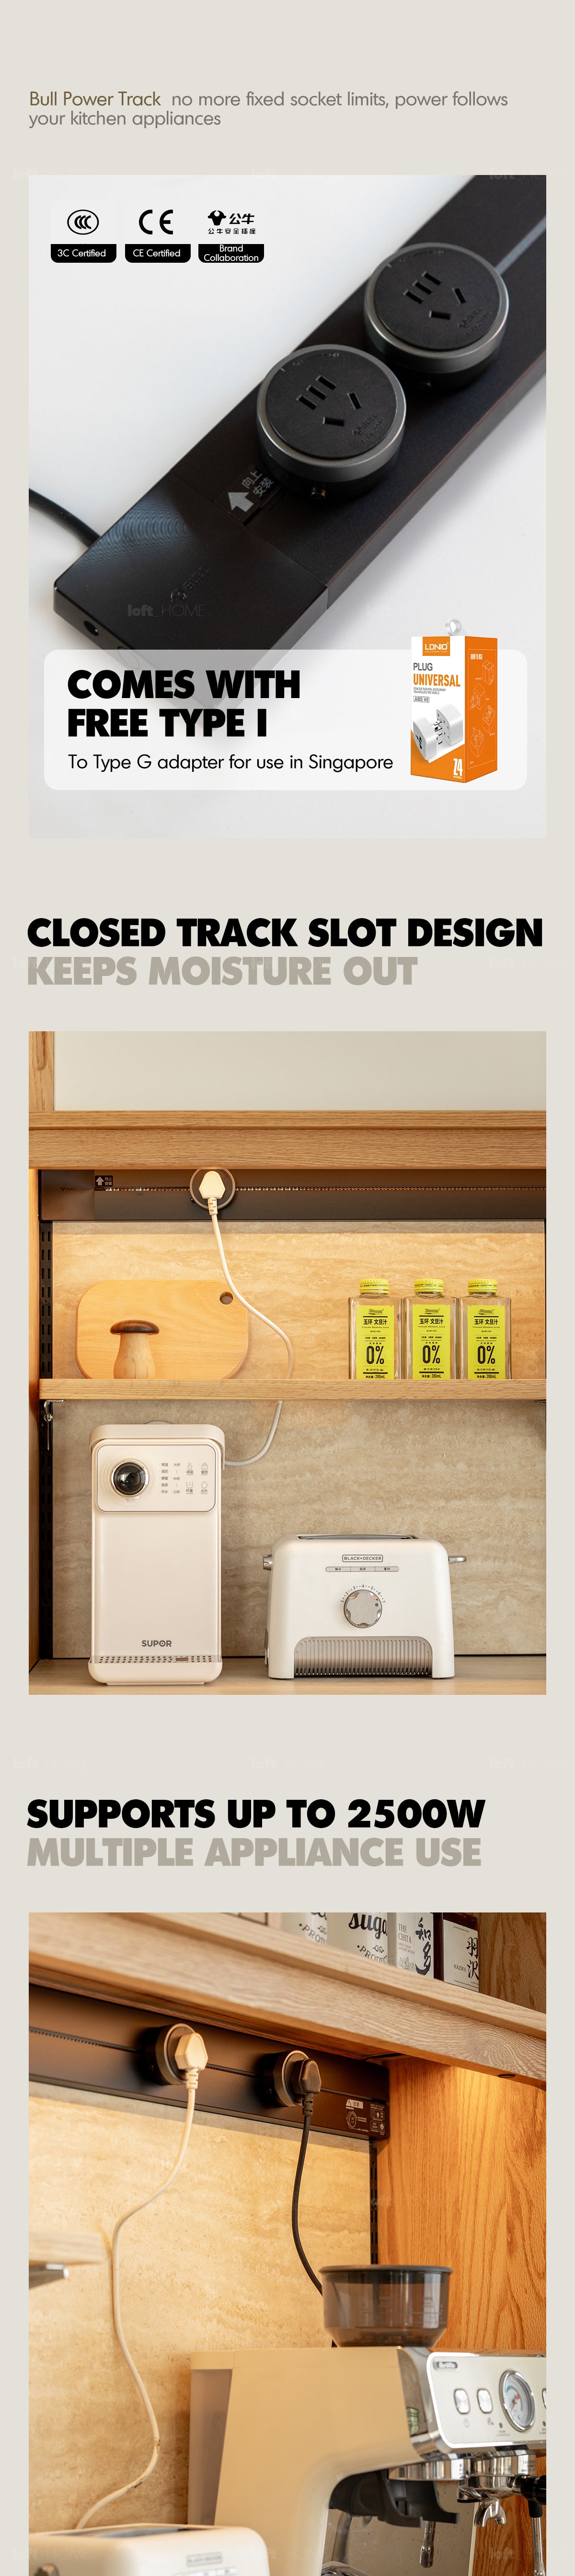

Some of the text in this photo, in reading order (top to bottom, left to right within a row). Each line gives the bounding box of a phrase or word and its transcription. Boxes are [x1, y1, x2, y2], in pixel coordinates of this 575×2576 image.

[242, 470, 263, 489] 向上
[252, 477, 274, 497] 安装
[414, 663, 433, 671] PLUG
[414, 674, 460, 687] UNIVERSAL
[366, 1346, 384, 1364] 0%
[422, 1345, 440, 1364] 0%
[477, 1346, 495, 1364] 0%
[399, 1923, 407, 1933] THE
[398, 1933, 412, 1944] CHITA
